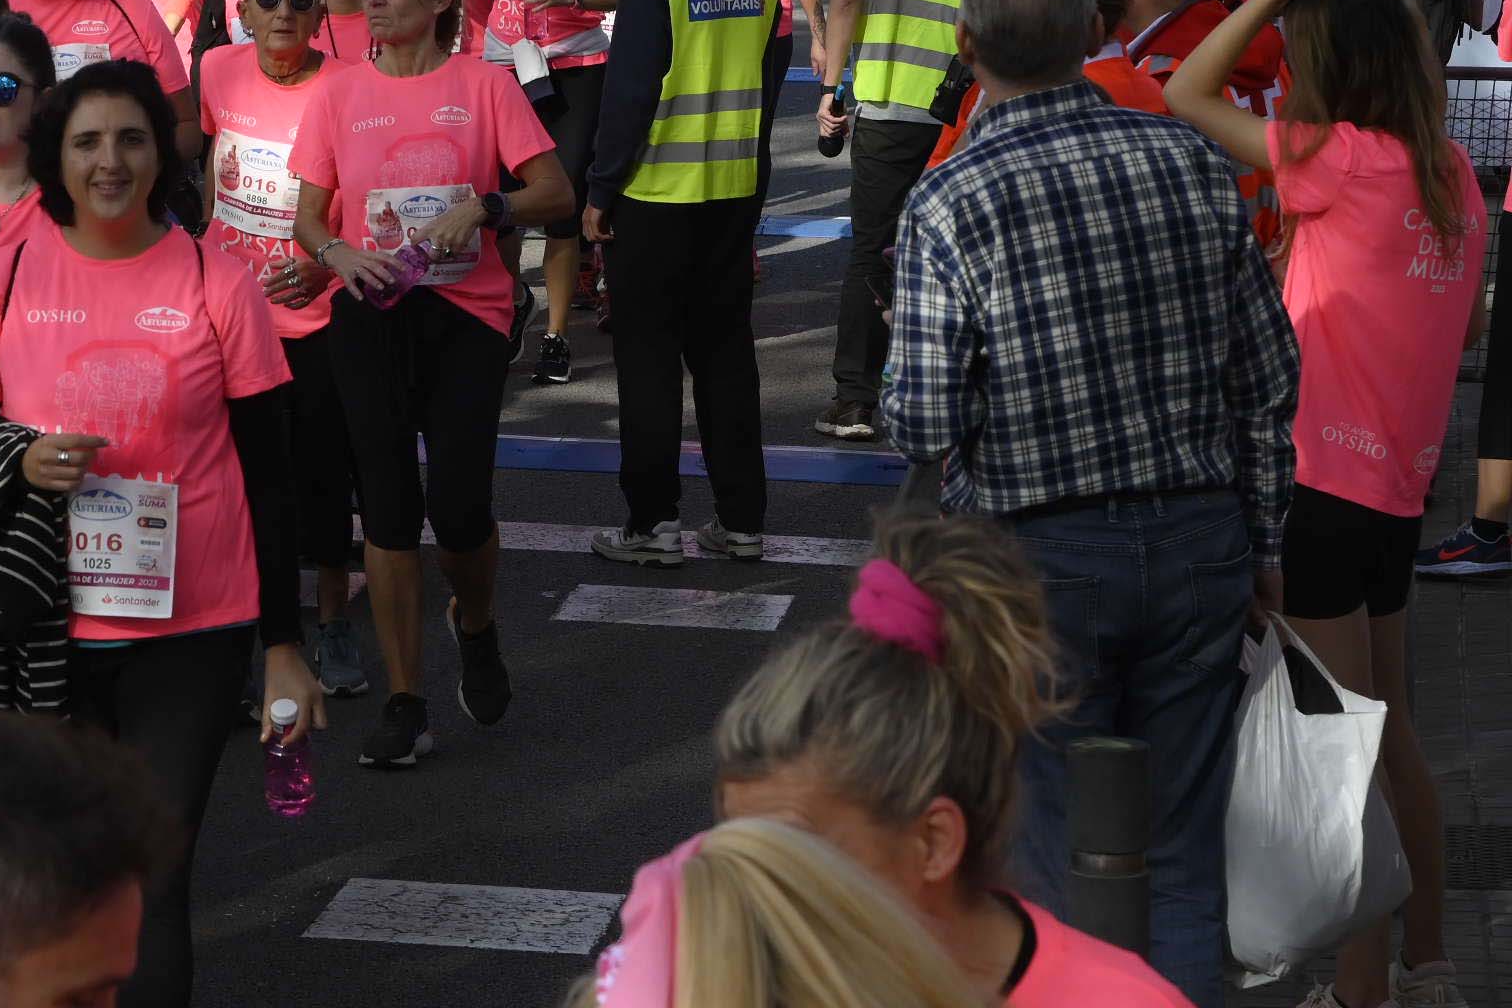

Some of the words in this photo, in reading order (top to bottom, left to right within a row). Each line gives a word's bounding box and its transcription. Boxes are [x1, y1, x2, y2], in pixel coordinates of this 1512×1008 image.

[352, 115, 396, 134] OYSHO
[244, 152, 283, 168] ASTURIANA
[242, 175, 277, 193] 016
[246, 193, 268, 205] 8898
[401, 203, 447, 215] ASTURIANA
[27, 309, 86, 324] OYSHO
[138, 315, 188, 329] ASTURIANA
[1322, 425, 1387, 460] OYSHO
[74, 502, 127, 514] ASTURIANA
[138, 499, 167, 509] SUMA
[76, 532, 124, 552] 016
[83, 558, 111, 570] 1025
[82, 576, 93, 584] DE
[93, 576, 104, 584] LA
[105, 577, 136, 585] MUJER
[114, 595, 161, 607] Santander
